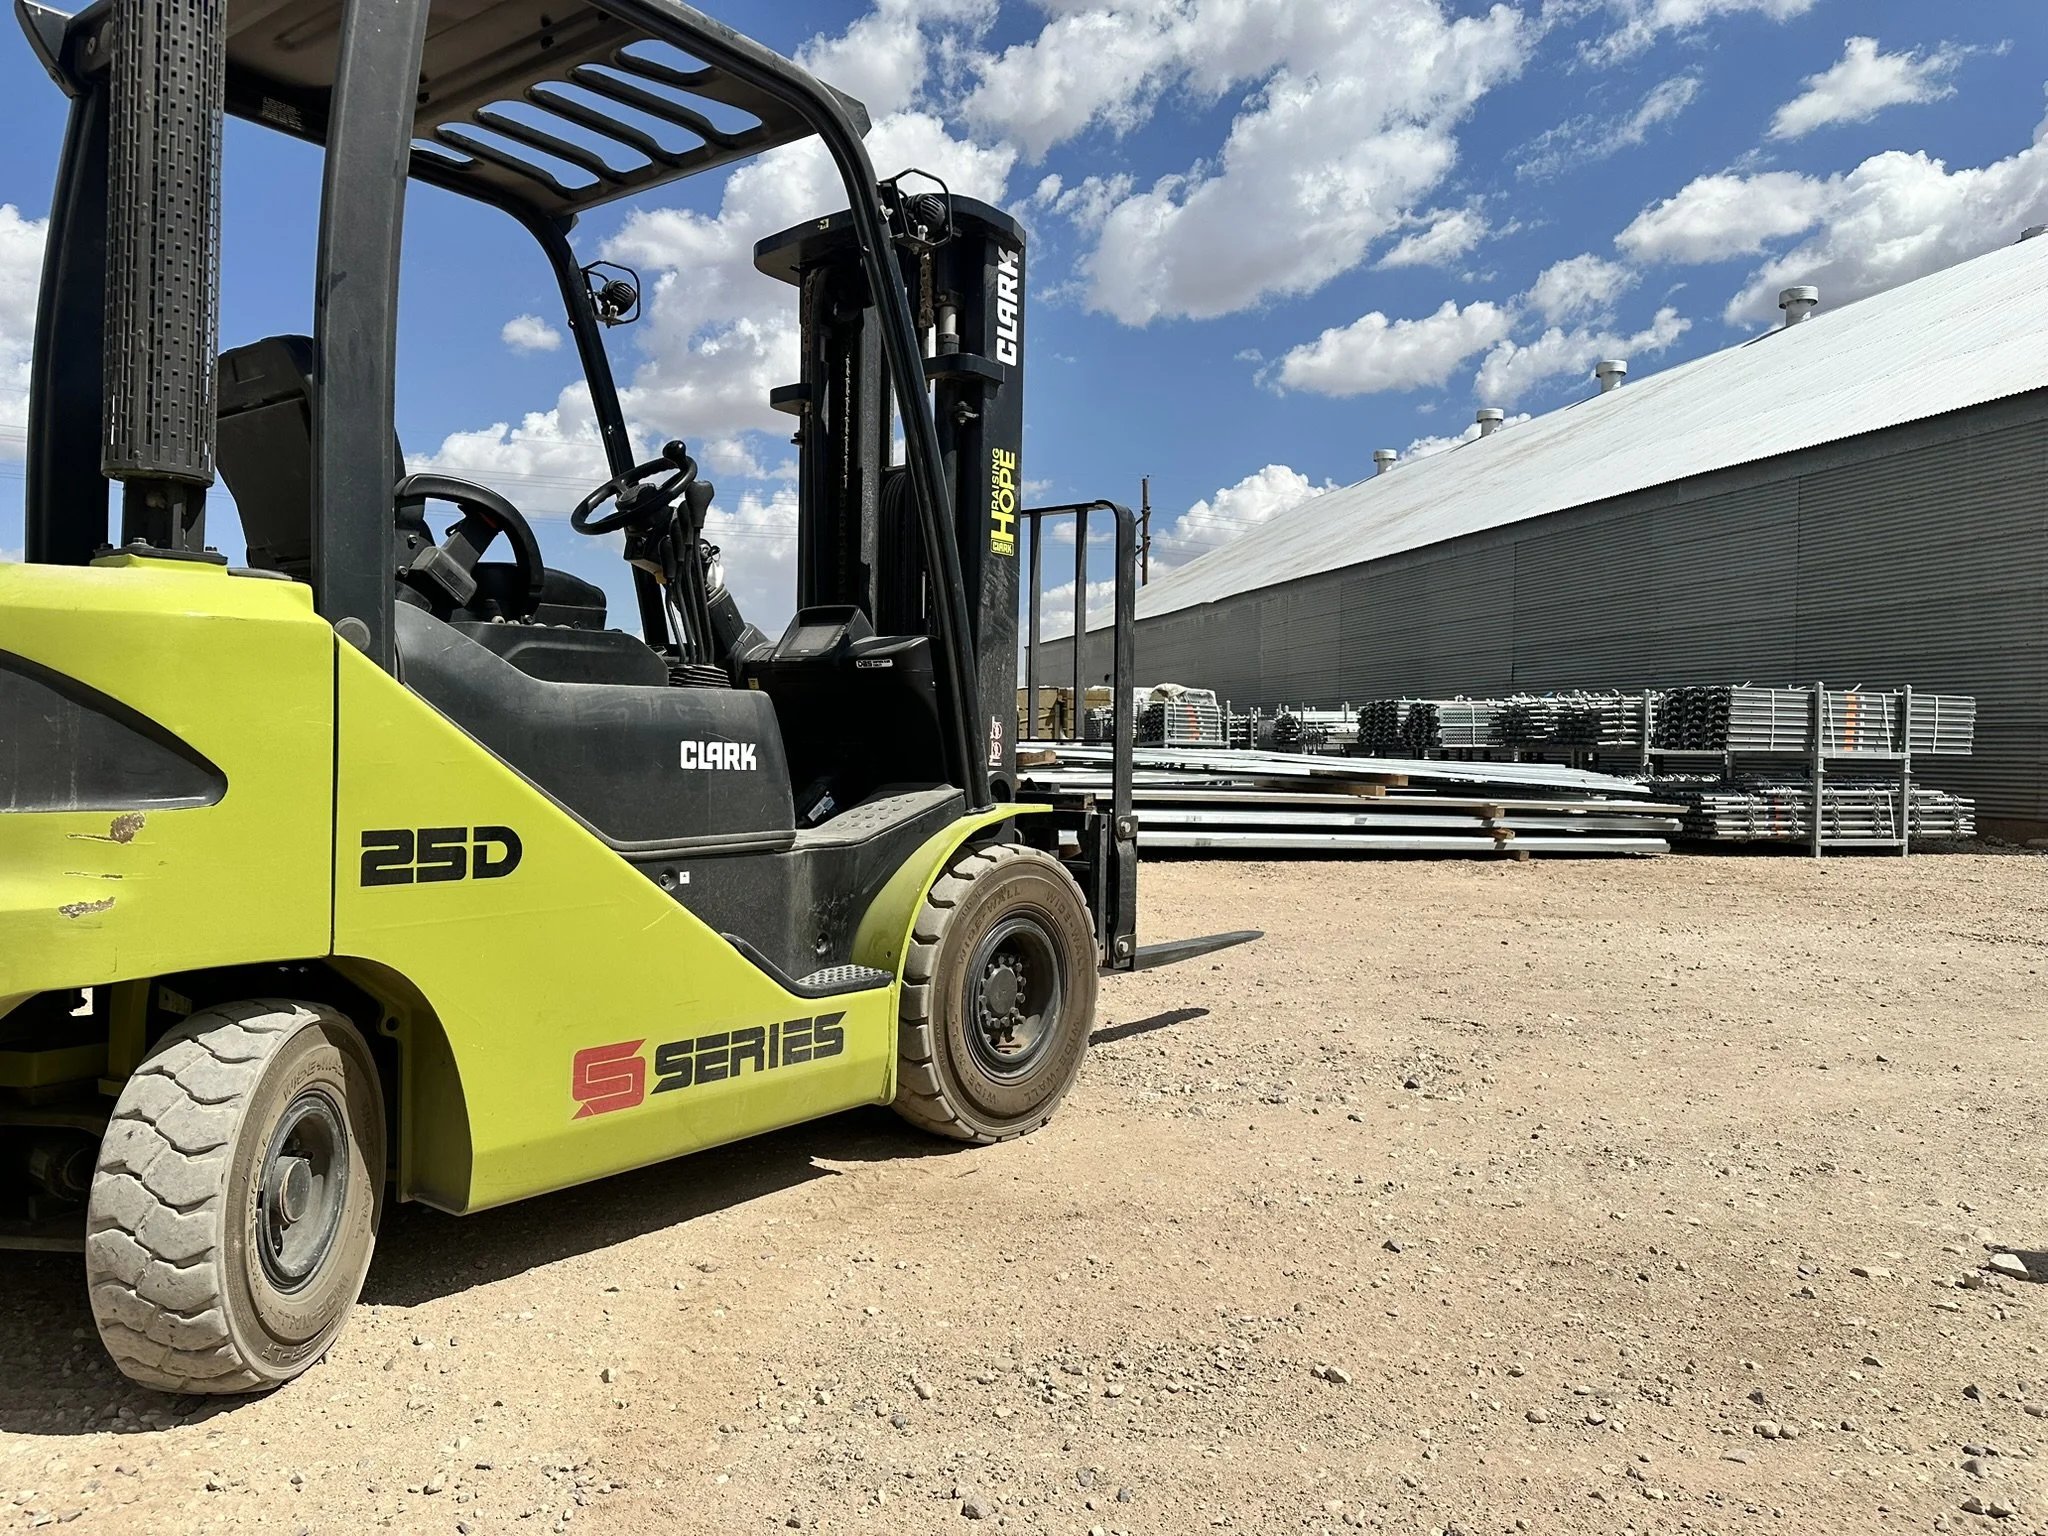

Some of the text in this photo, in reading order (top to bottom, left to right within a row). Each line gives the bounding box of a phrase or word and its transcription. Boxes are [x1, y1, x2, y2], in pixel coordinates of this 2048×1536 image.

[997, 246, 1018, 367] CLARK
[991, 447, 1001, 511] RAISING
[991, 448, 1016, 543] HOPE
[680, 740, 757, 771] CLARK
[360, 826, 523, 887] 25D
[957, 885, 1022, 966] WIDE-WALL
[1045, 890, 1084, 977] WIDE-WALL
[571, 1038, 647, 1120] S
[650, 1010, 847, 1095] SERIES
